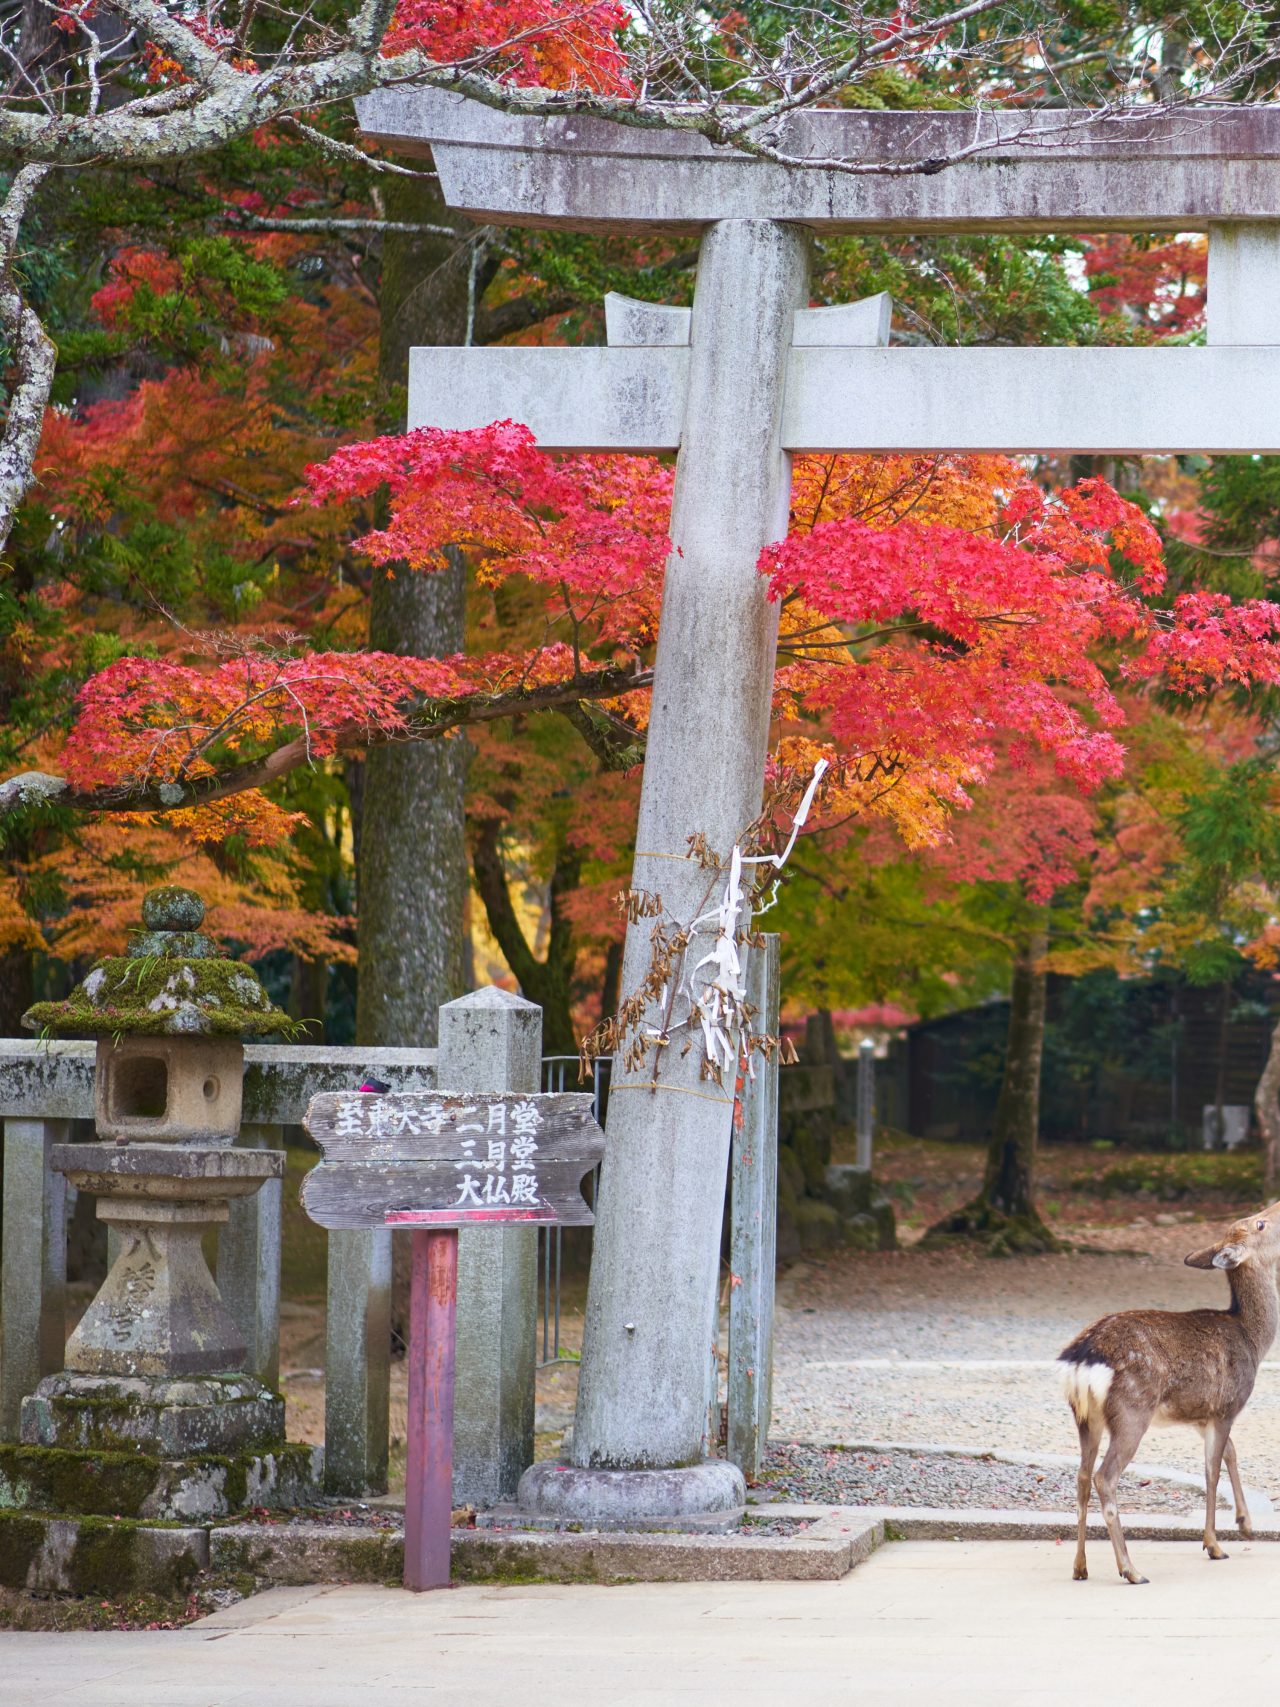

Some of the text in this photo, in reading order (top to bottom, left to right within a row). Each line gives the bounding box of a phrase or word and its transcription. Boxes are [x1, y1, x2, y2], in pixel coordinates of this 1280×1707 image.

[454, 1136, 539, 1172] 三月堂
[455, 1174, 540, 1206] 大仏殿
